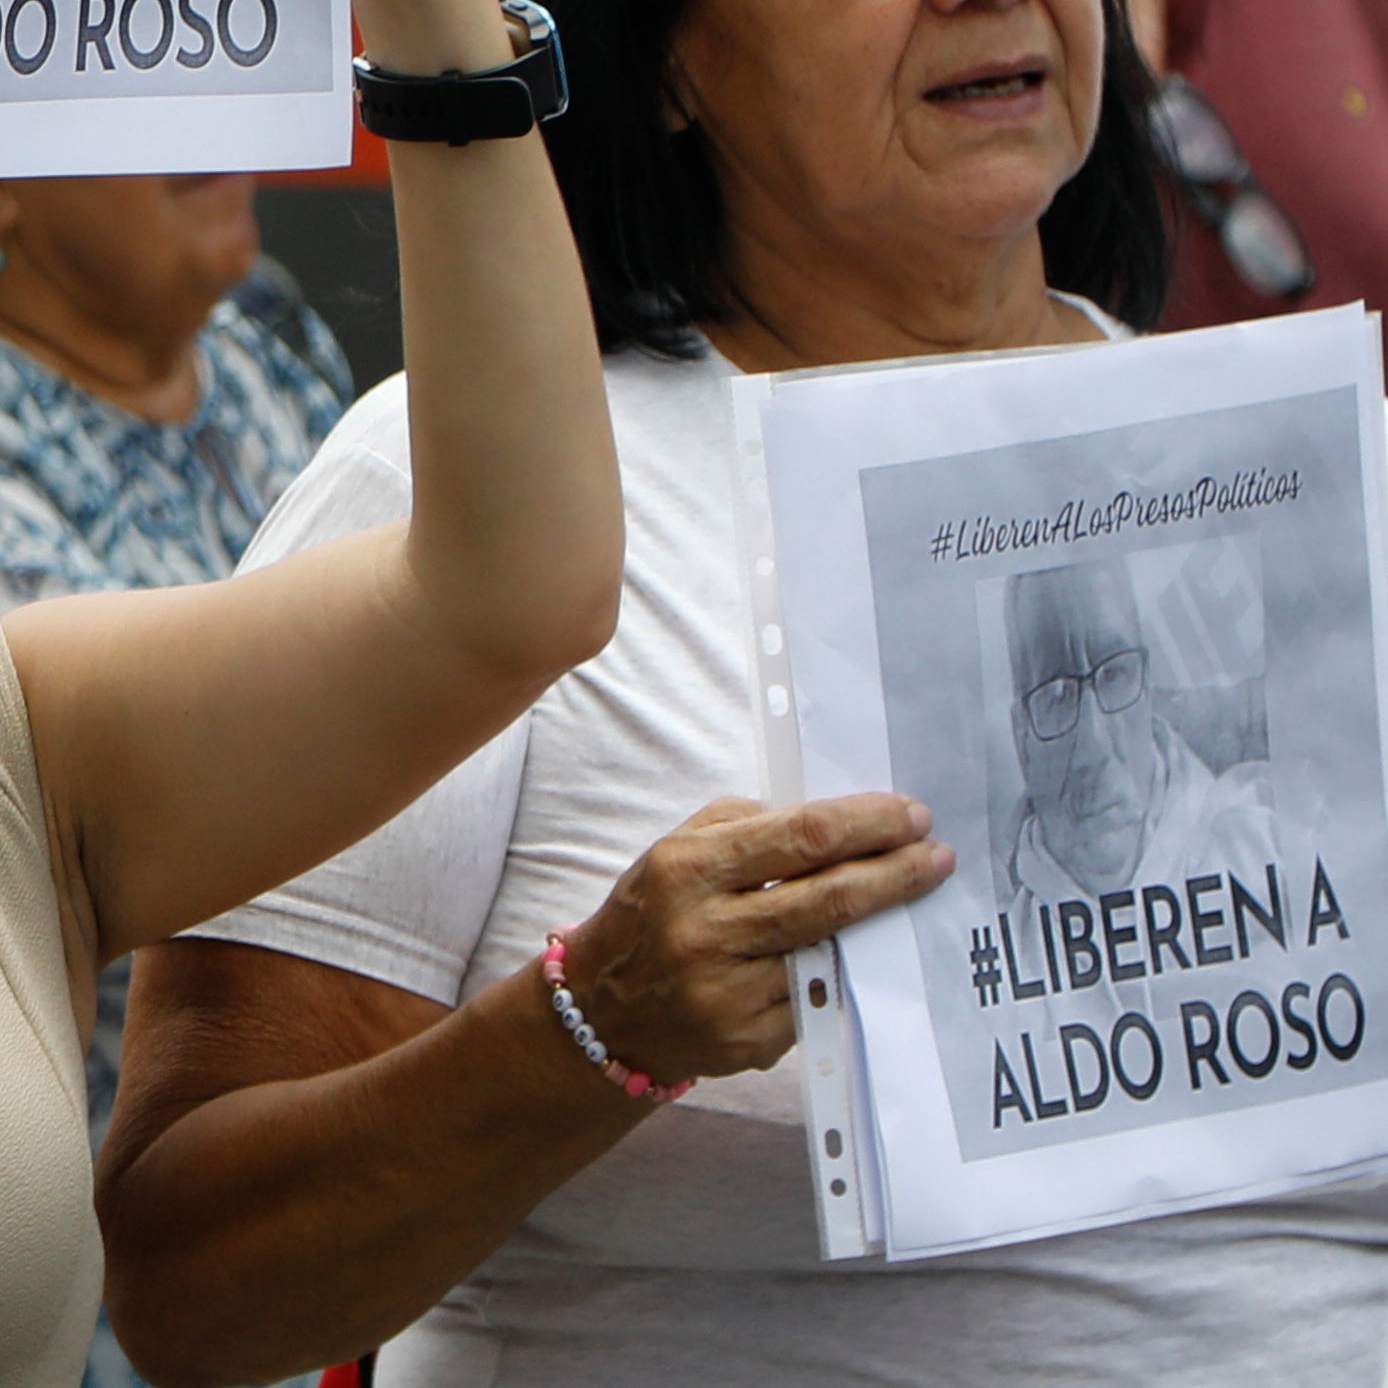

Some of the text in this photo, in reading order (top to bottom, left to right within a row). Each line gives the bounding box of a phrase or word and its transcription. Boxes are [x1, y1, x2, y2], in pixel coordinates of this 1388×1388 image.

[968, 856, 1343, 1008] #LIBEREN A
[993, 971, 1367, 1130] ALDO ROSO
